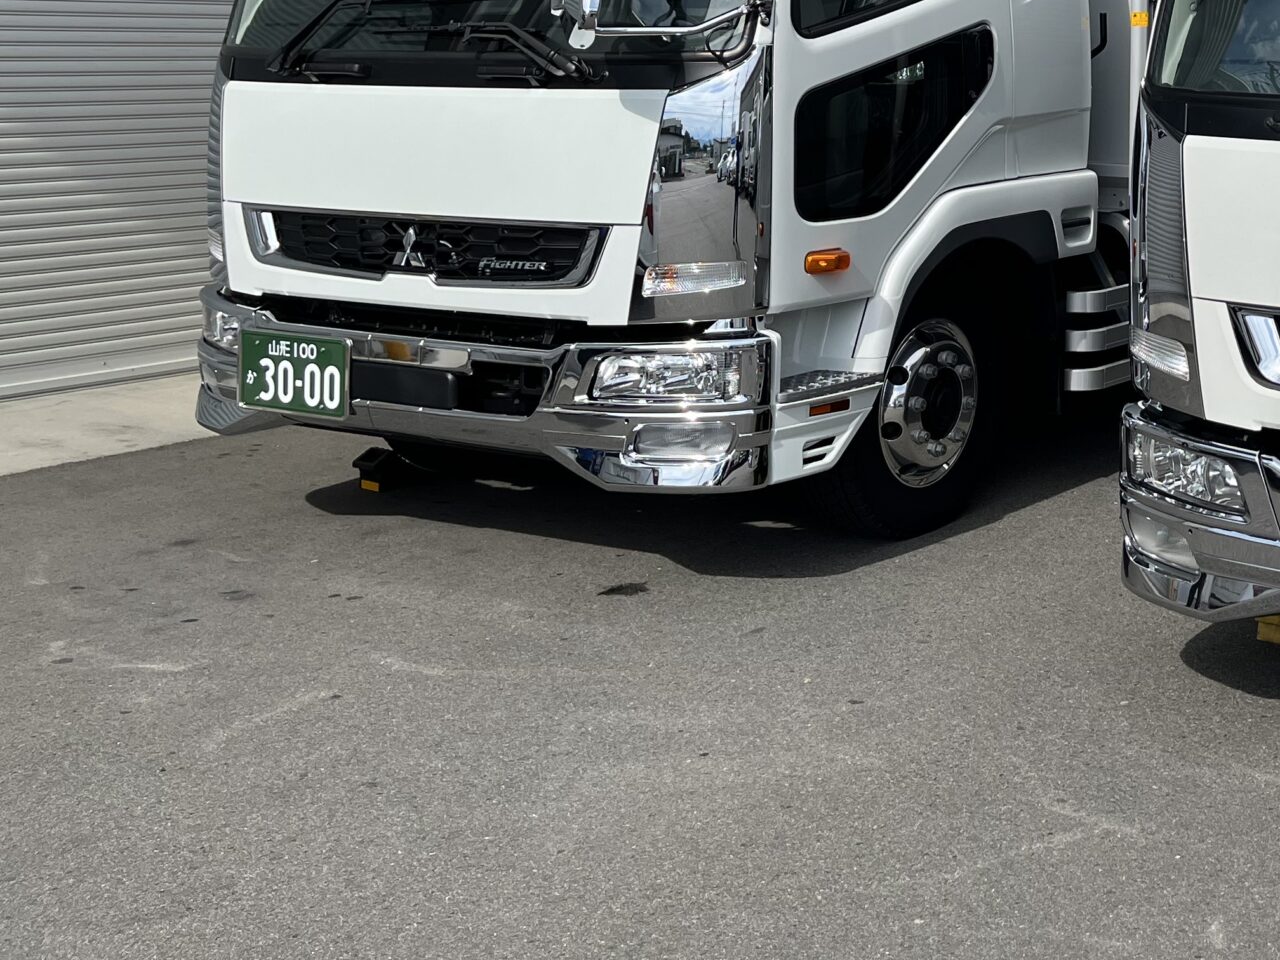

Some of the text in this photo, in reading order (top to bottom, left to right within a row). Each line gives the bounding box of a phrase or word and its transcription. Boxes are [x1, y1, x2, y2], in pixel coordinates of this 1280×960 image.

[479, 257, 547, 271] FIGHTER
[268, 340, 317, 359] 山形 100
[259, 357, 341, 410] 30-00
